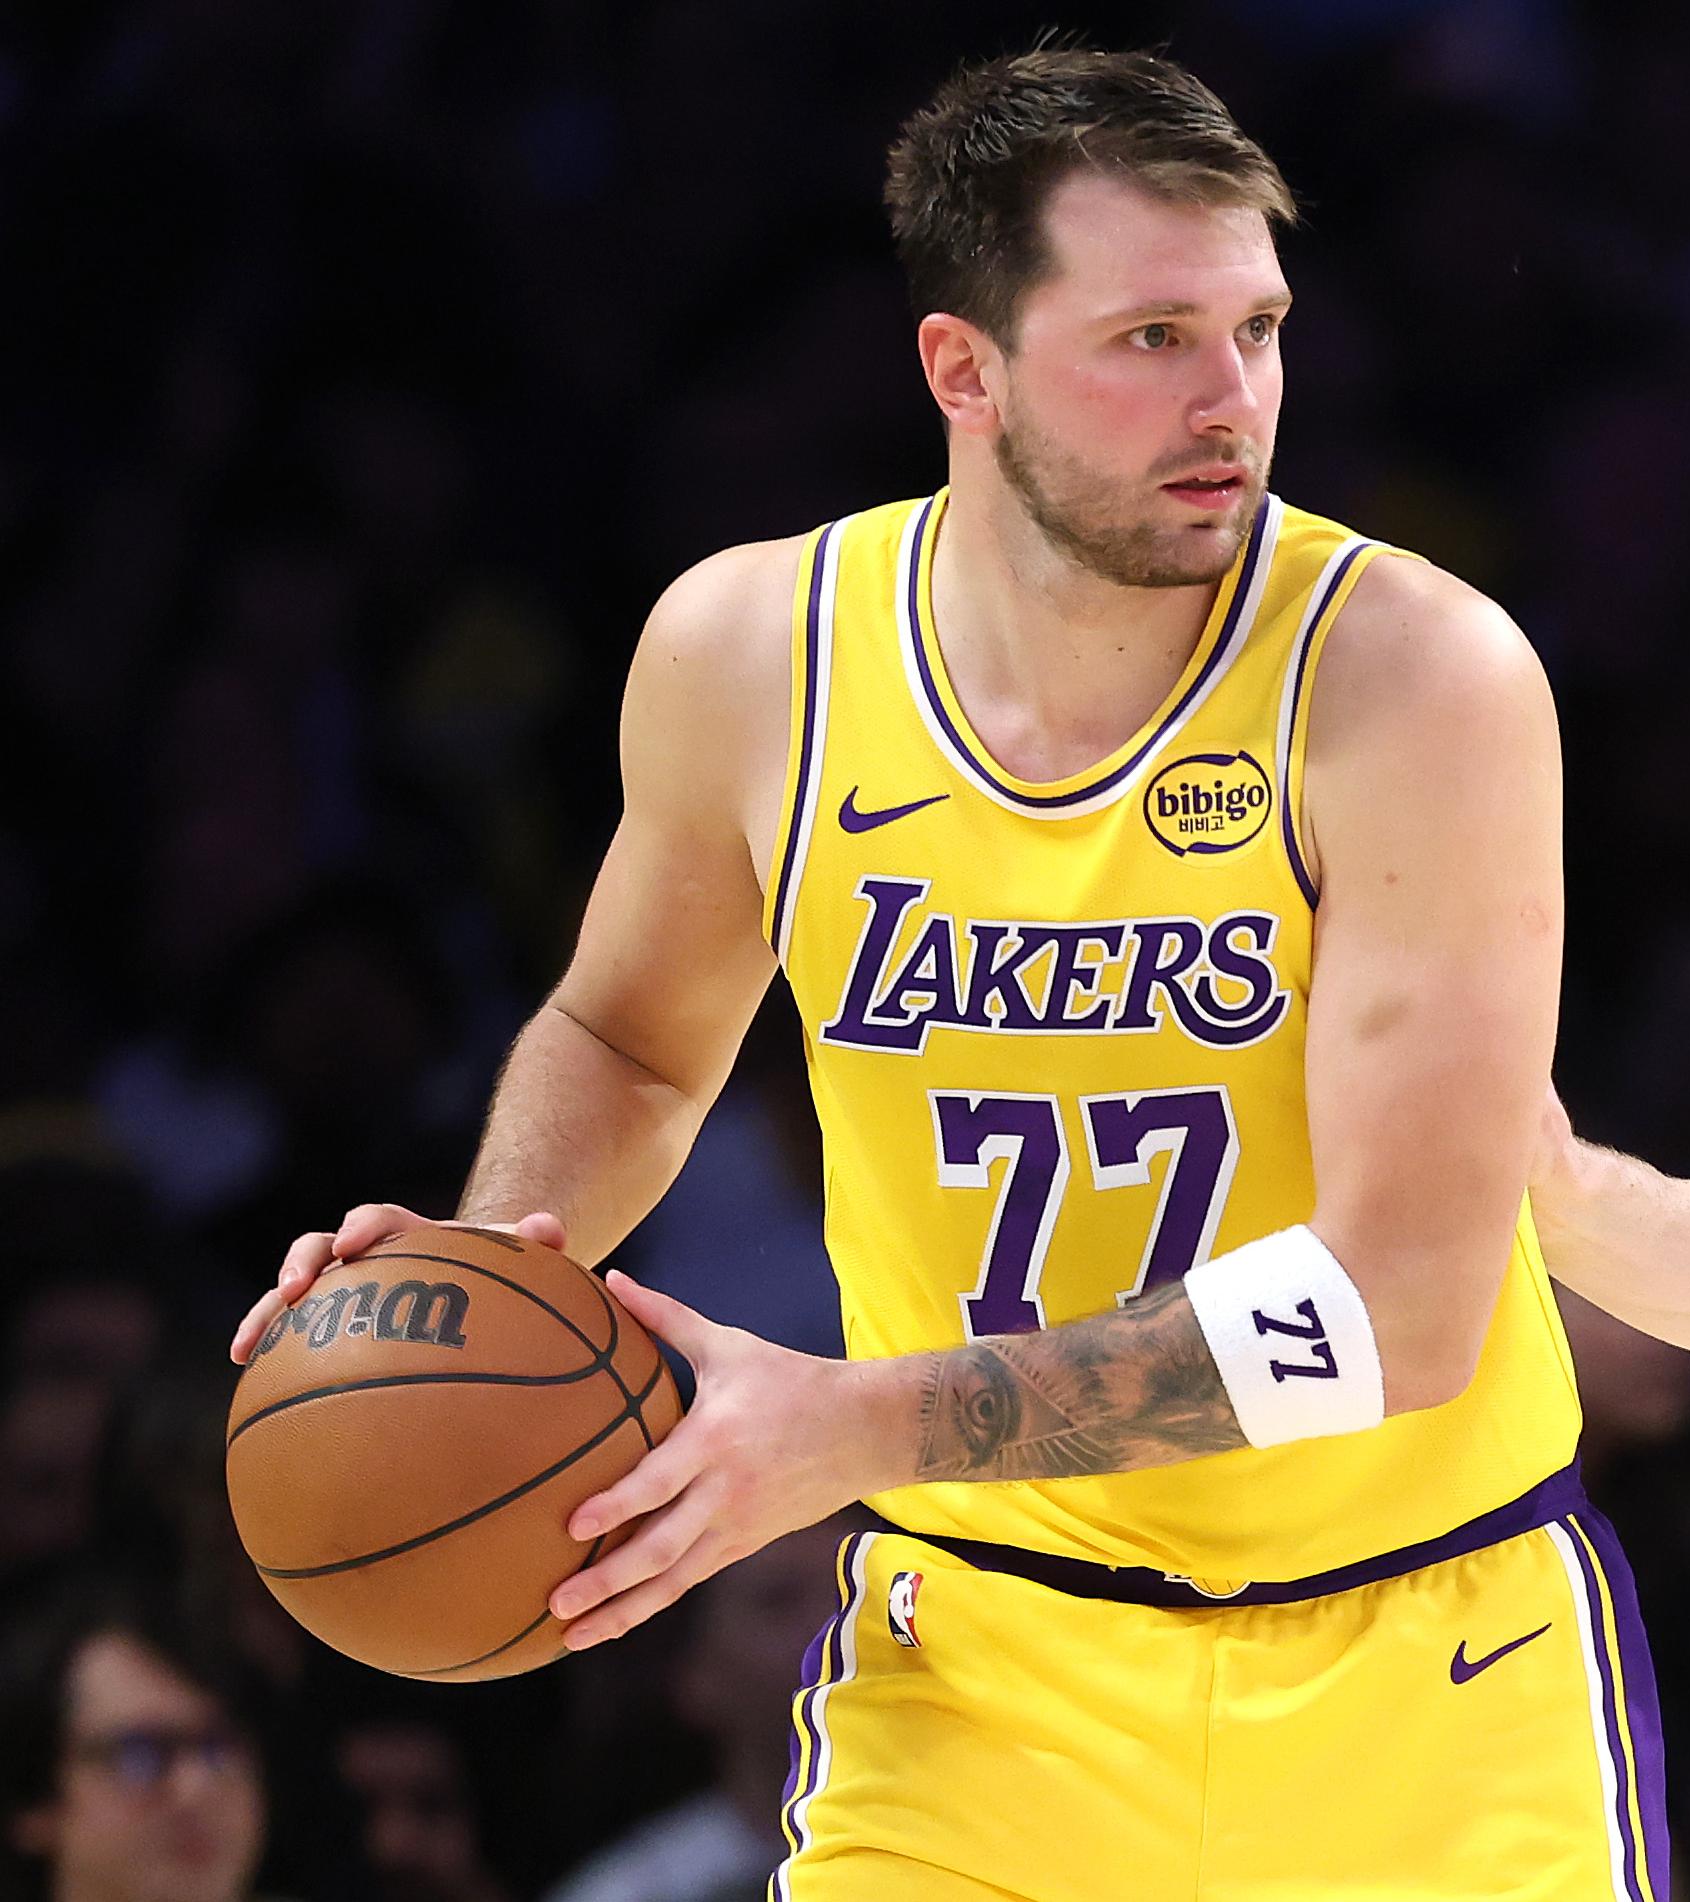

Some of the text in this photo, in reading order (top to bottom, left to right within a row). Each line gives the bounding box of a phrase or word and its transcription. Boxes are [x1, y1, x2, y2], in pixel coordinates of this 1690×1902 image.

[1156, 780, 1265, 822] bibigo
[1178, 814, 1225, 834] 비비고
[818, 873, 1292, 1057] LAKERS
[927, 1084, 1241, 1345] 77
[245, 1280, 470, 1368] Wilso
[1251, 1297, 1339, 1383] 77
